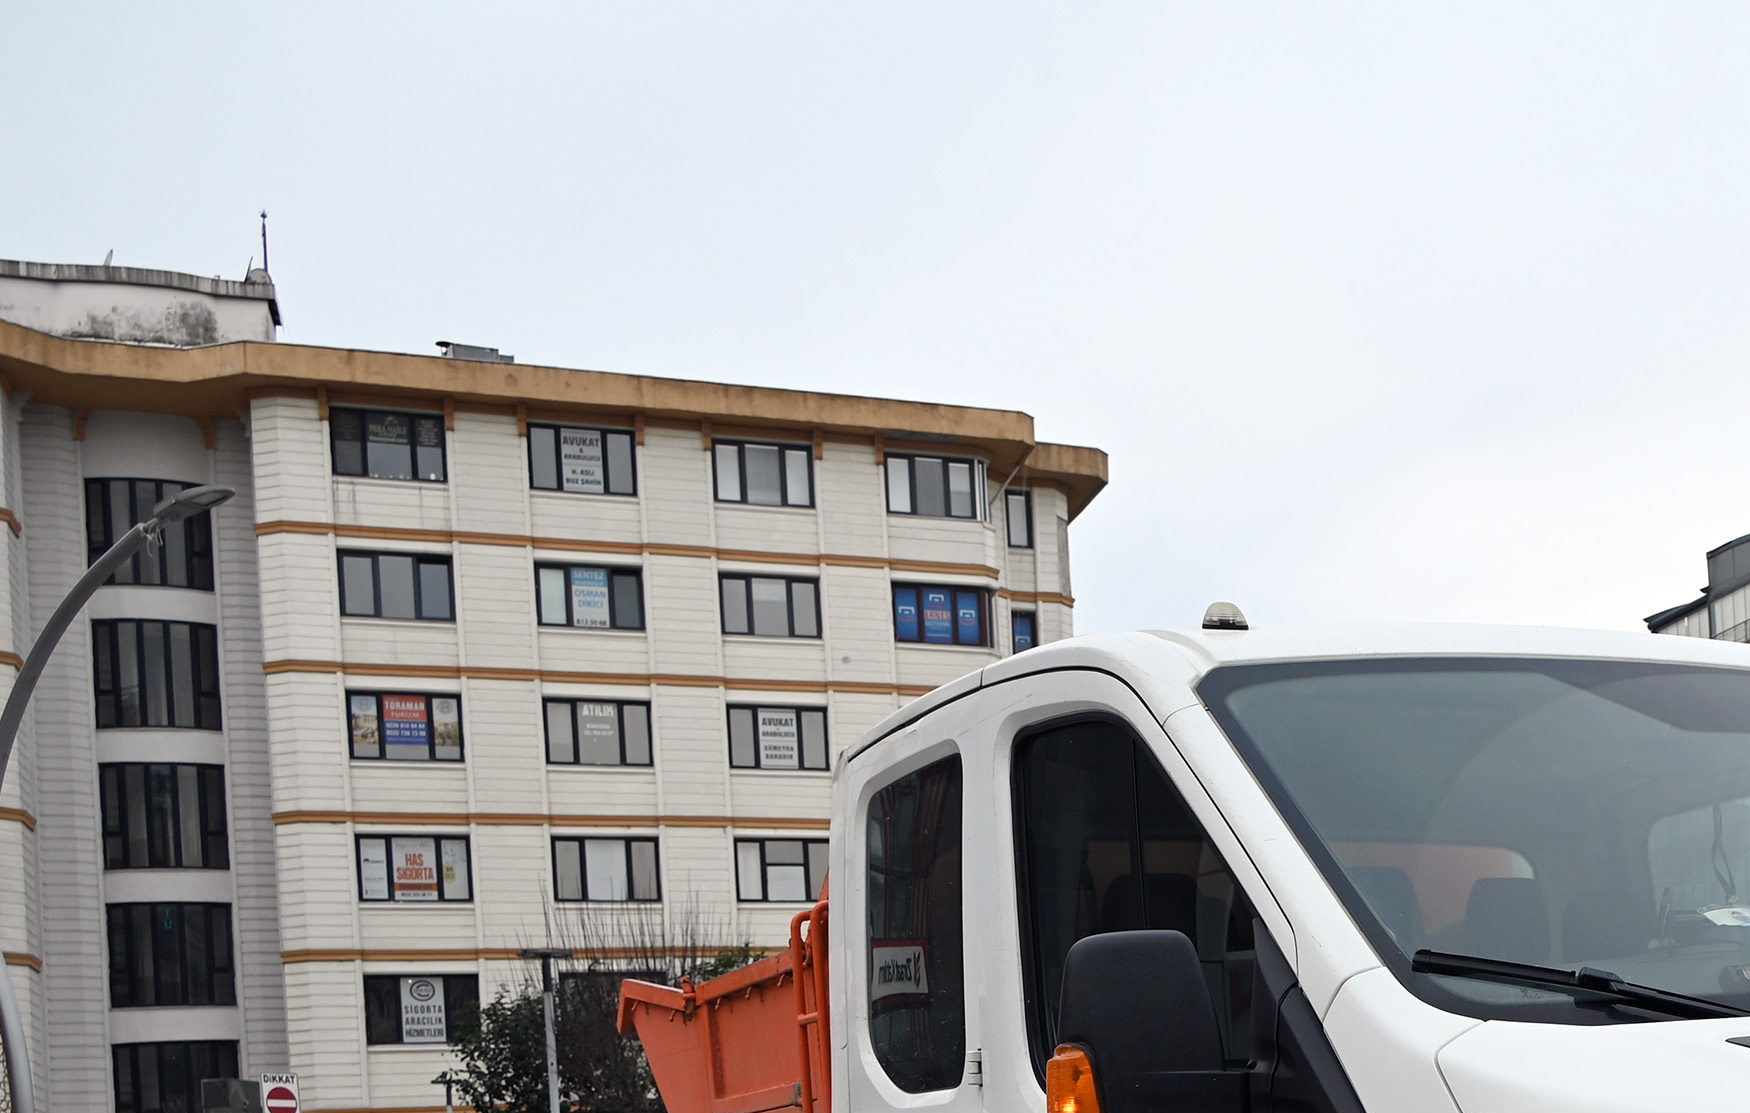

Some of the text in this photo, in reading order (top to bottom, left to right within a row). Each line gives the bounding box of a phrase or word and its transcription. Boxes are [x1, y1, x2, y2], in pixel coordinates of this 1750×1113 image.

[562, 436, 599, 447] AVUKAT
[573, 570, 604, 580] SENTEZ
[574, 590, 606, 598] OSMAN
[385, 701, 425, 711] TORAMAN
[582, 704, 614, 717] ATILIM
[762, 717, 794, 727] AVUKAT
[405, 853, 424, 866] HAS
[405, 1016, 444, 1025] ARACILIK
